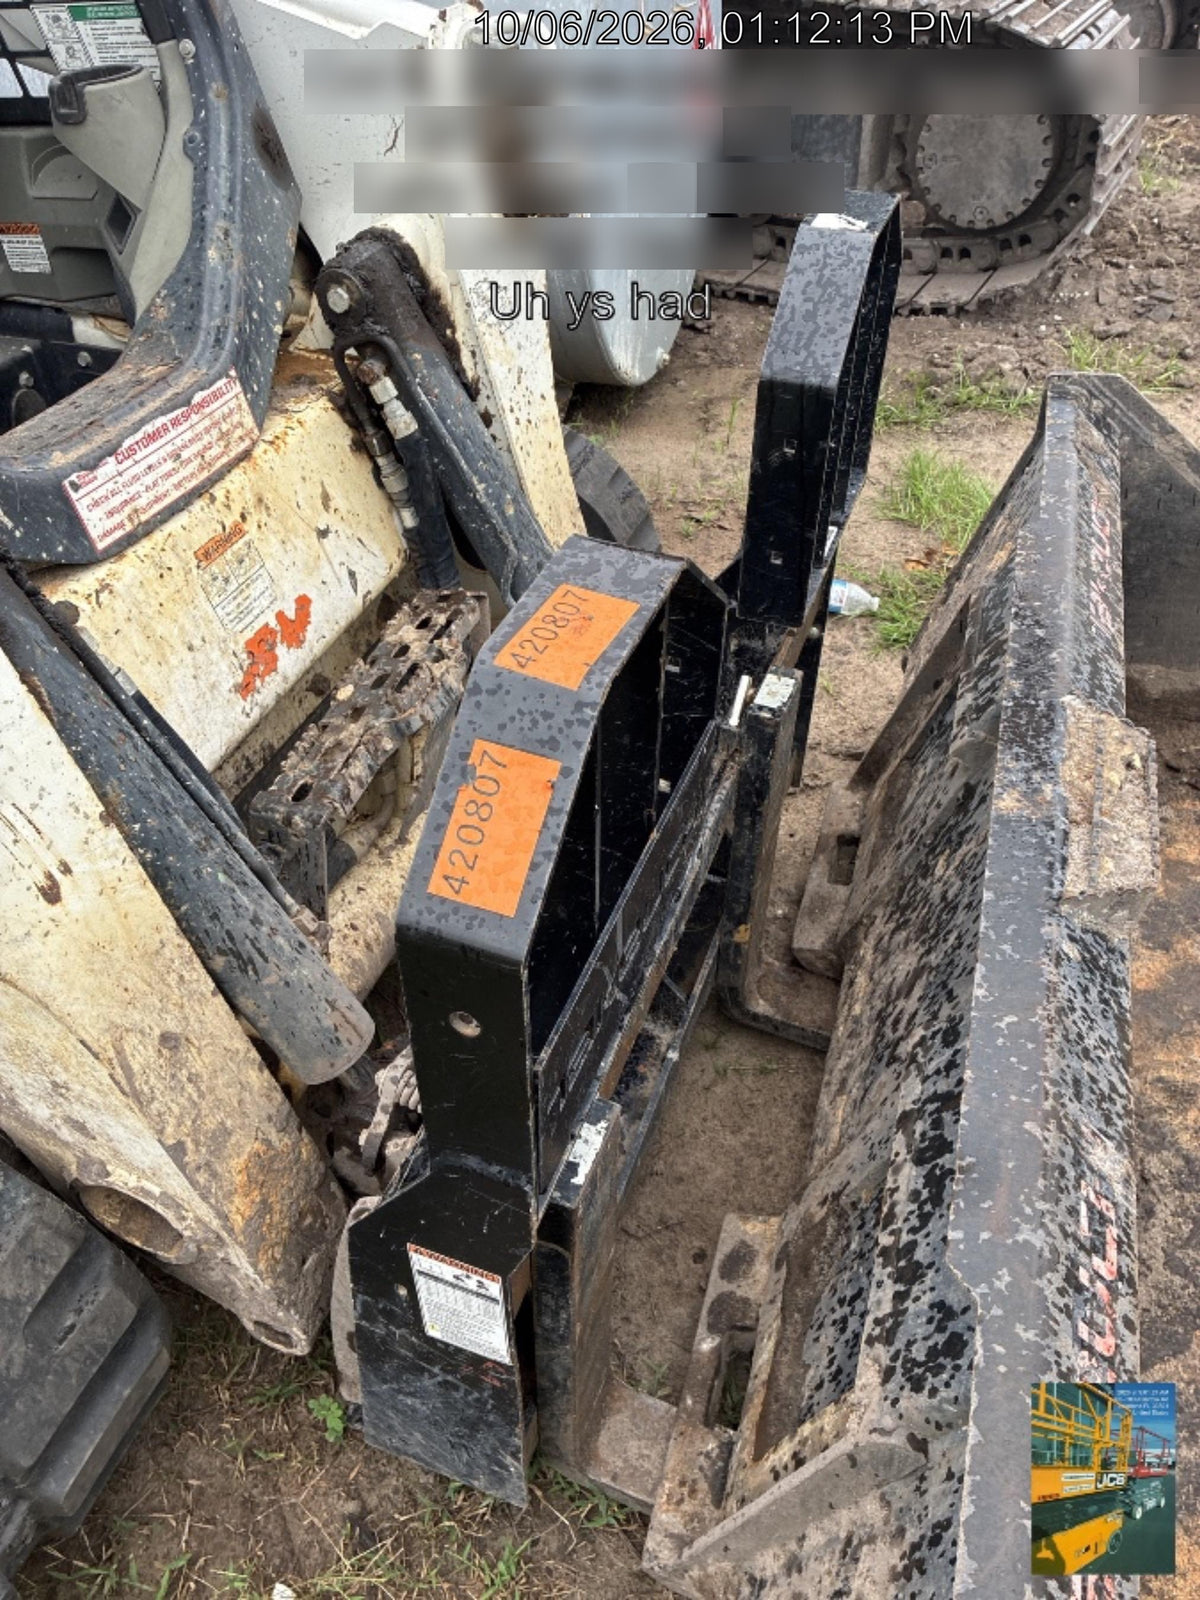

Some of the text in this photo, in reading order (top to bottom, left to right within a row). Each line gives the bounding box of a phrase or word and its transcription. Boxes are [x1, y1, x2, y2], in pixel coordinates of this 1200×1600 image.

[114, 423, 170, 465] CUSTOMER
[170, 378, 238, 430] RESPONSIBILITY
[510, 590, 590, 669] 420807
[442, 750, 507, 895] 420807
